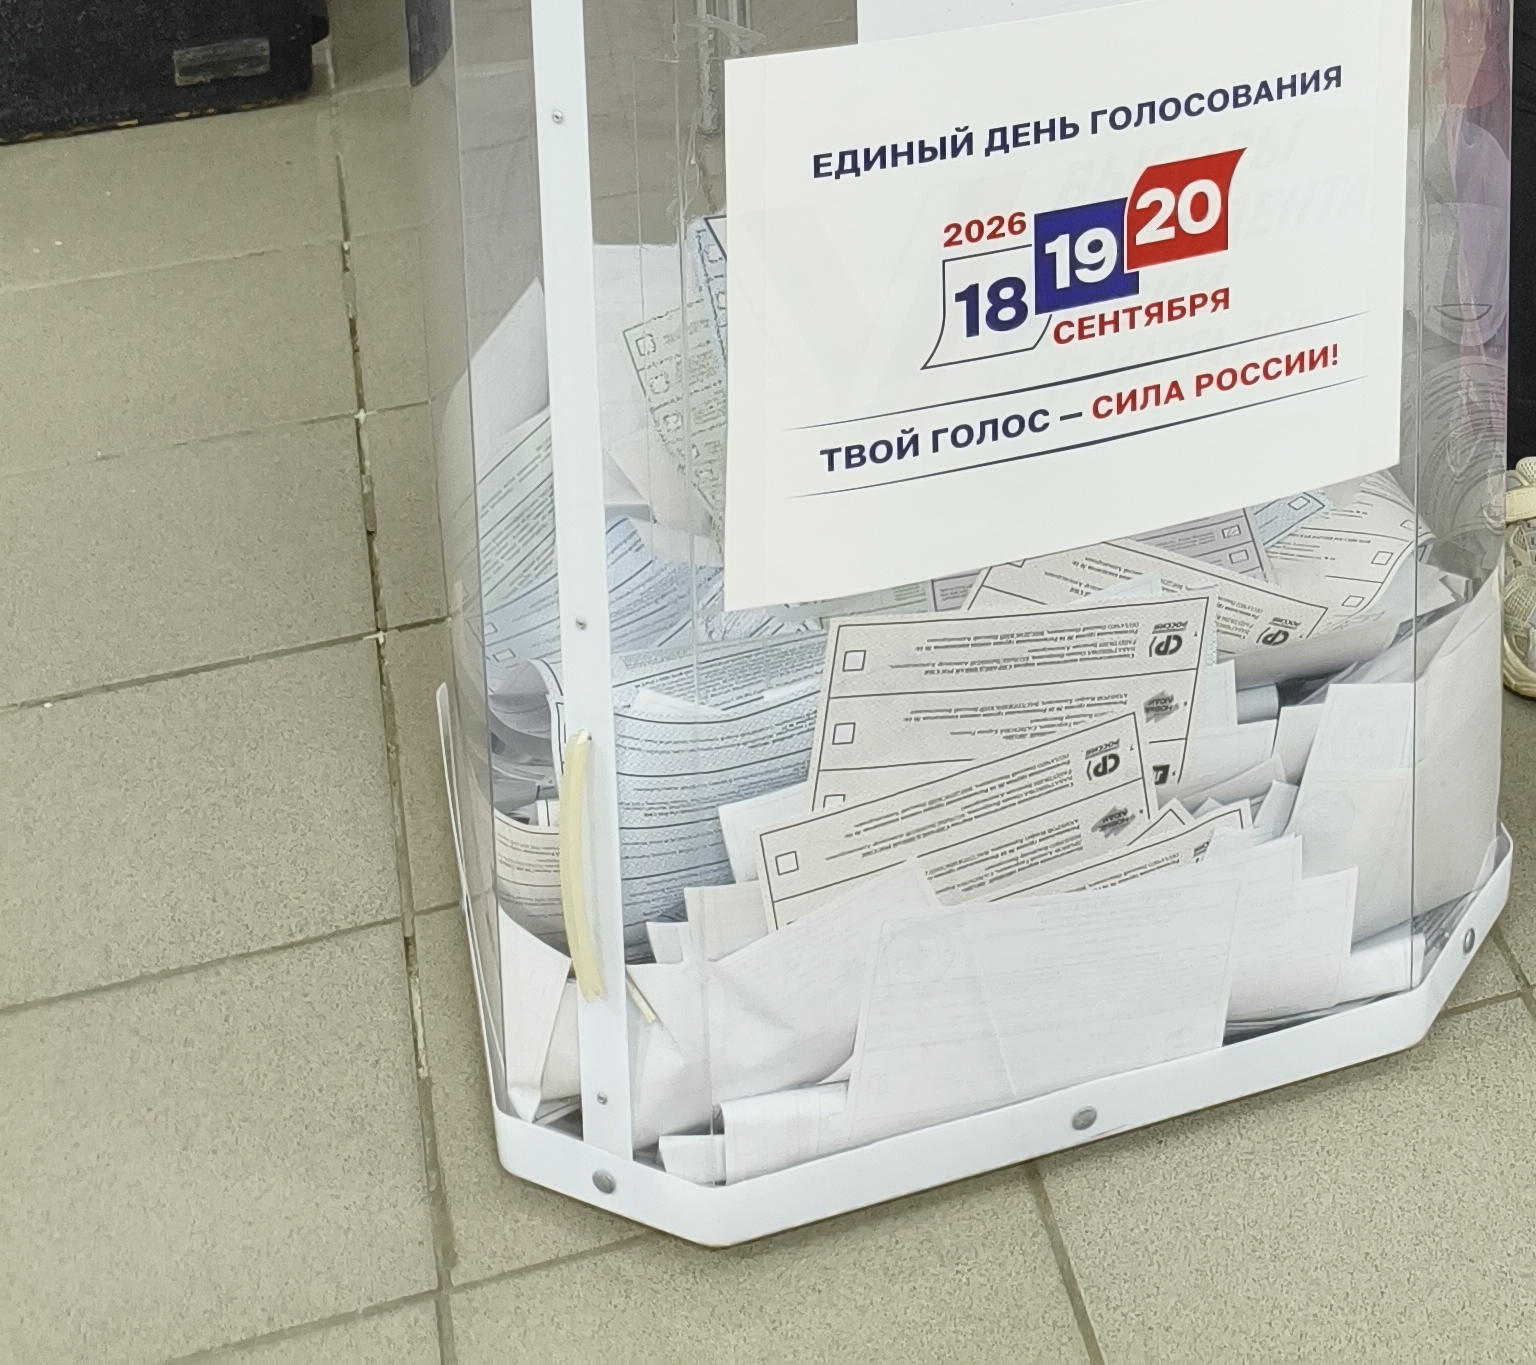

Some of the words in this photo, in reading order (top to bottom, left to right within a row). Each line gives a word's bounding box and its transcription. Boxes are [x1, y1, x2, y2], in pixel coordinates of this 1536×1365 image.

[813, 125, 974, 180] ЕДИНЫЙ
[984, 116, 1080, 158] ДЕНЬ
[1090, 64, 1342, 135] ГОЛОСОВАНИЯ
[943, 211, 1027, 248] 2026
[954, 276, 1029, 338] 18
[1045, 227, 1118, 290] 19
[1135, 178, 1222, 246] 20
[1053, 287, 1230, 345] СЕНТЯБРЯ
[819, 427, 920, 472] ТВОЙ
[931, 408, 1050, 454] ГОЛОС
[1092, 379, 1185, 420] СИЛА
[1194, 343, 1338, 398] РОССИИ!
